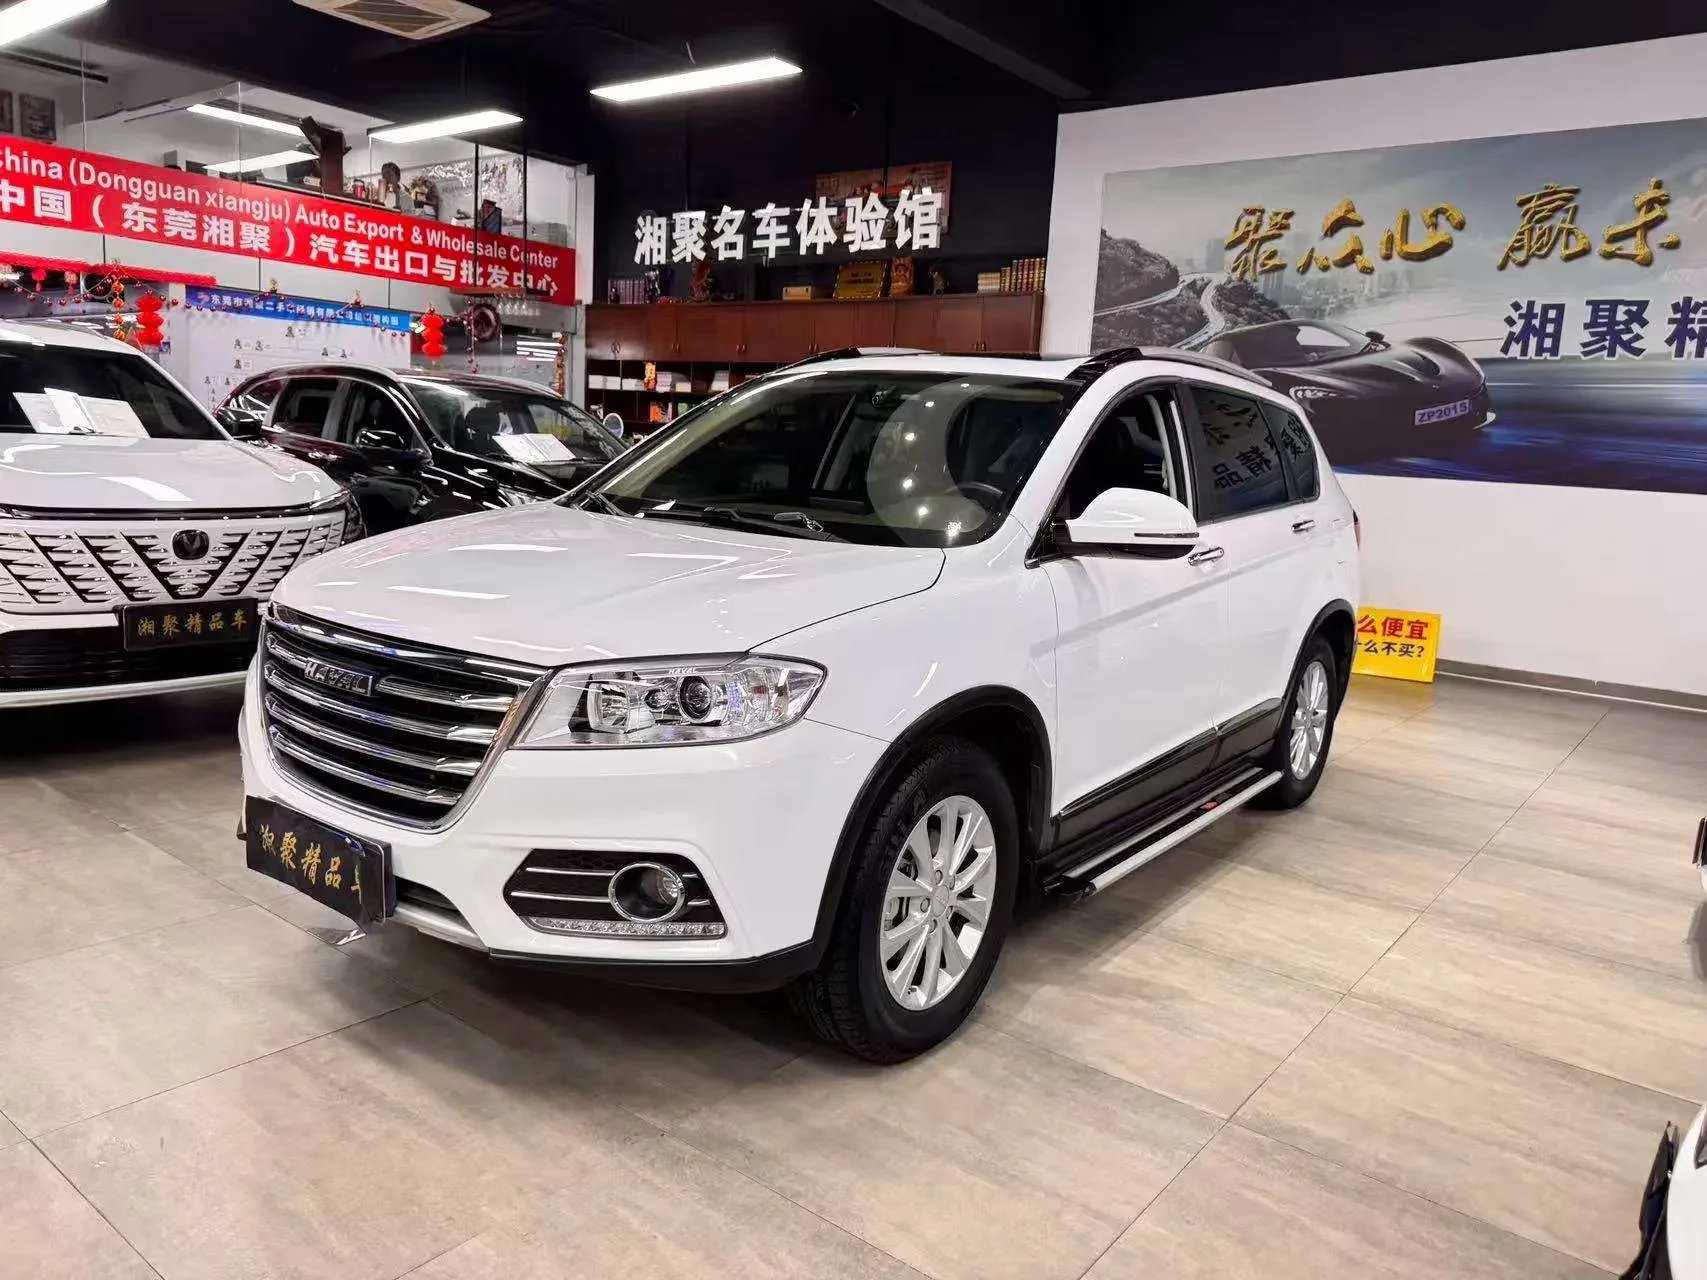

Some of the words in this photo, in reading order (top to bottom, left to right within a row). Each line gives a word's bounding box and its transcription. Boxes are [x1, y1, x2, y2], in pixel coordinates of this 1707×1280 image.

[69, 157, 200, 205] (Dongguan
[206, 190, 291, 224] xiangju)
[295, 204, 340, 230] Auto
[344, 214, 404, 242] Export
[411, 226, 423, 244] &
[427, 228, 506, 258] Wholesale
[634, 186, 943, 266] 湘聚名车体验馆
[1417, 401, 1468, 423] ZP2015
[137, 607, 249, 637] 湘聚精品车
[1357, 639, 1425, 658] 么不买?
